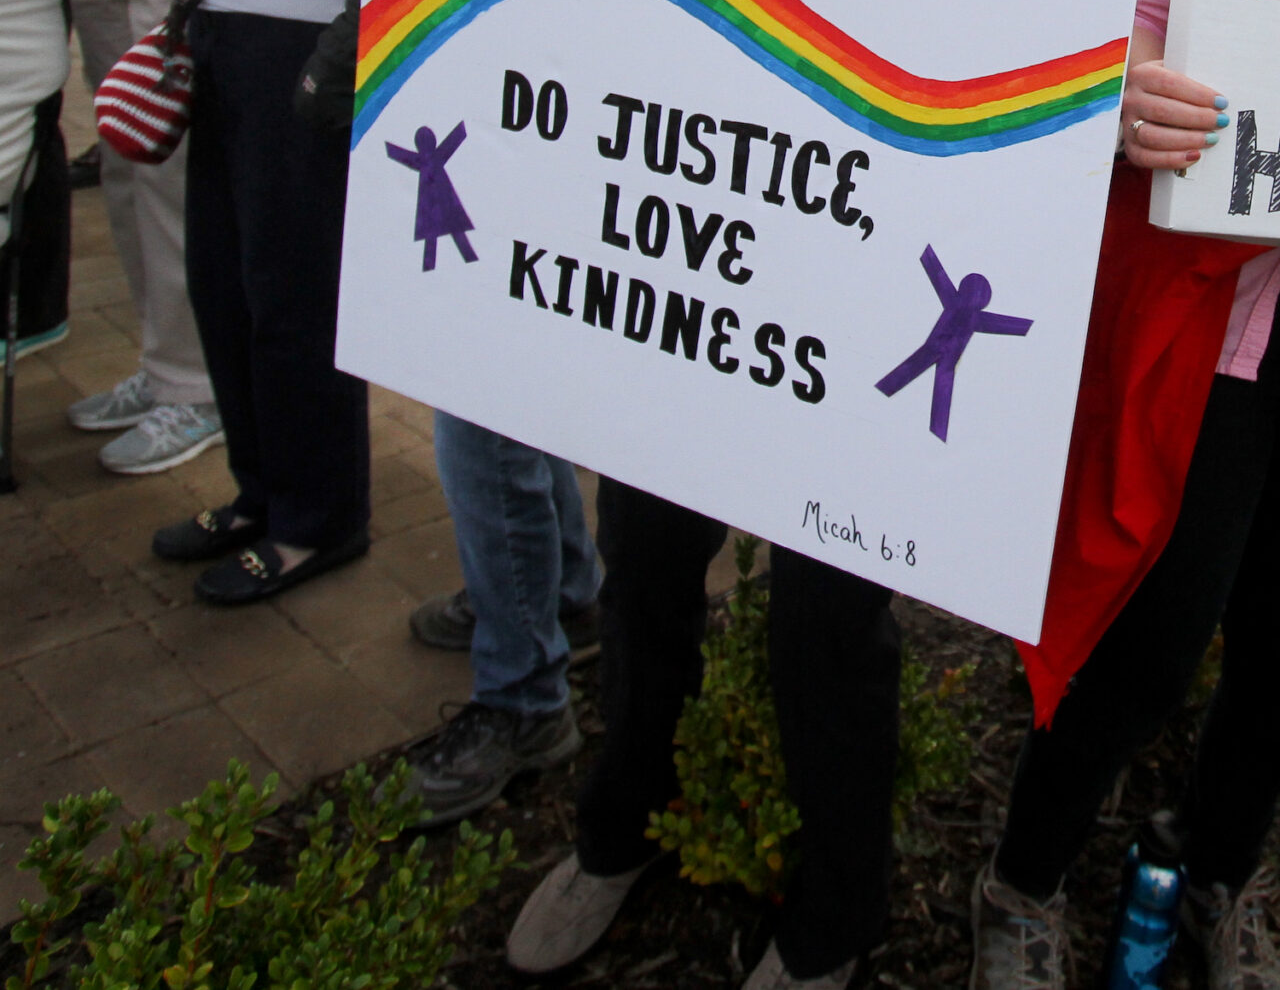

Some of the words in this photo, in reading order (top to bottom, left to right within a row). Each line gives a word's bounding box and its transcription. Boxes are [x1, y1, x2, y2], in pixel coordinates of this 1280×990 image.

[501, 69, 569, 141] DO
[597, 92, 874, 241] JUSTICE,
[601, 182, 756, 286] LOVE
[509, 239, 827, 405] KINDNESS
[802, 500, 868, 551] Micah
[881, 533, 916, 567] 6:8
